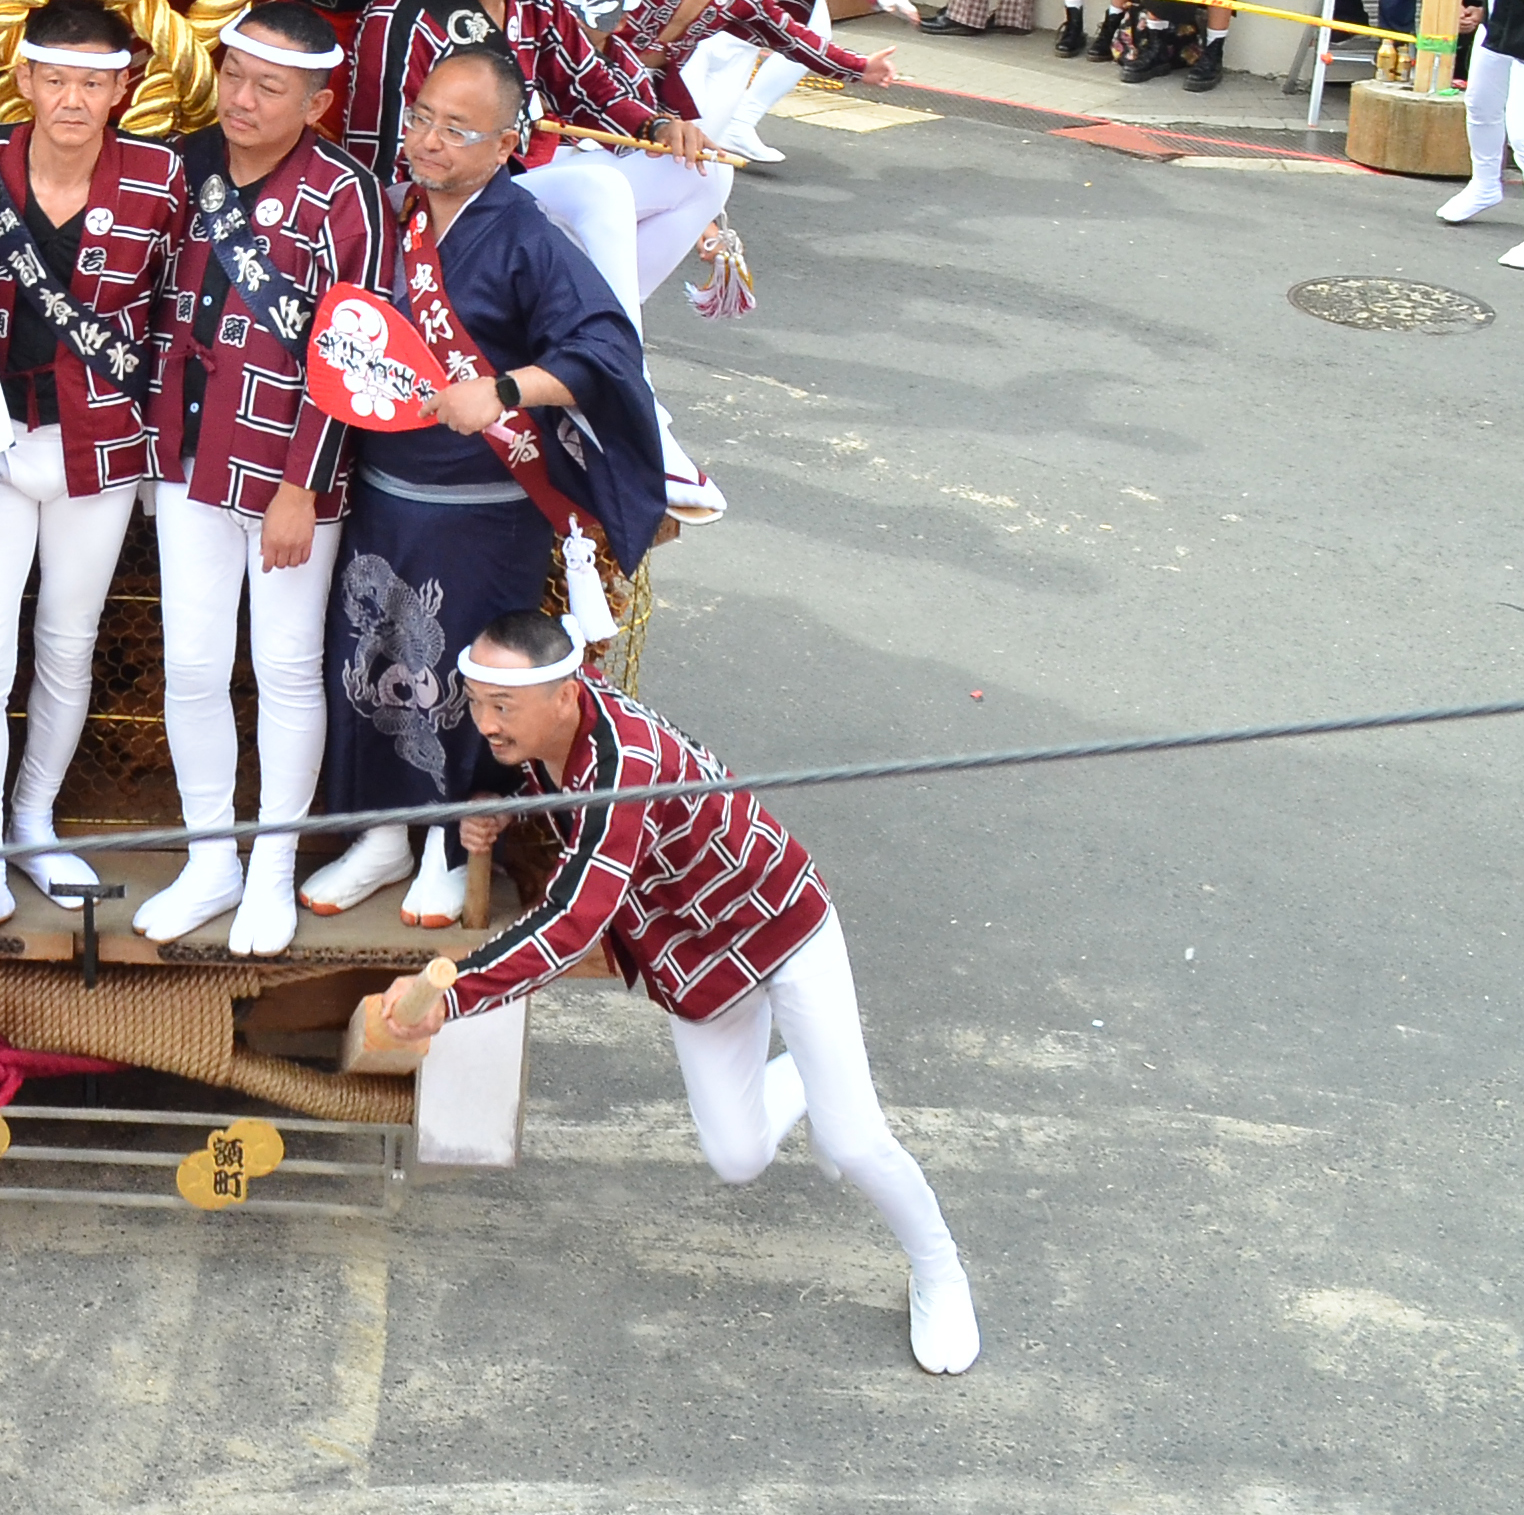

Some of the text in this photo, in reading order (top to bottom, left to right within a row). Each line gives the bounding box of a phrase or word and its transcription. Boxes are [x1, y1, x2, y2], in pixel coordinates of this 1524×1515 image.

[8, 243, 141, 381] 副責任者
[411, 262, 540, 467] 曳行責者
[213, 1137, 244, 1198] 額町
